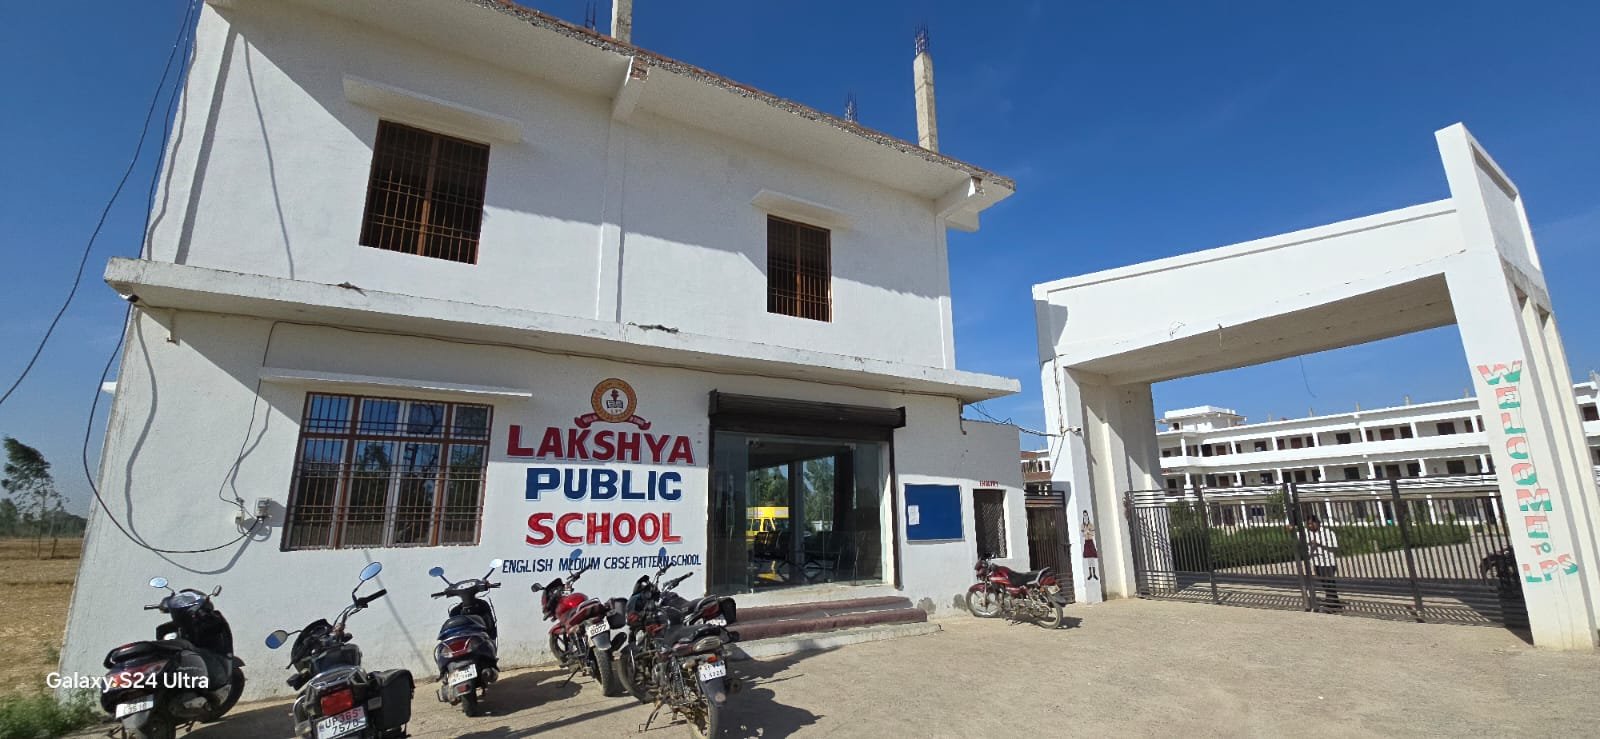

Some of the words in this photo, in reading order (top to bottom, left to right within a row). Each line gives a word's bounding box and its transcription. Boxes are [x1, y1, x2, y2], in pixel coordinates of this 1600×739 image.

[507, 425, 695, 464] LAKSHYA
[1477, 360, 1553, 538] WELCOME
[525, 467, 682, 501] PUBLIC
[525, 512, 682, 545] SCHOOL
[502, 559, 554, 573] ENGLISH
[559, 557, 600, 571] MEDIUM
[603, 556, 631, 569] CBSE
[632, 556, 669, 568] PATTERN
[671, 554, 702, 566] SCHOOL
[1522, 554, 1578, 583] LPS
